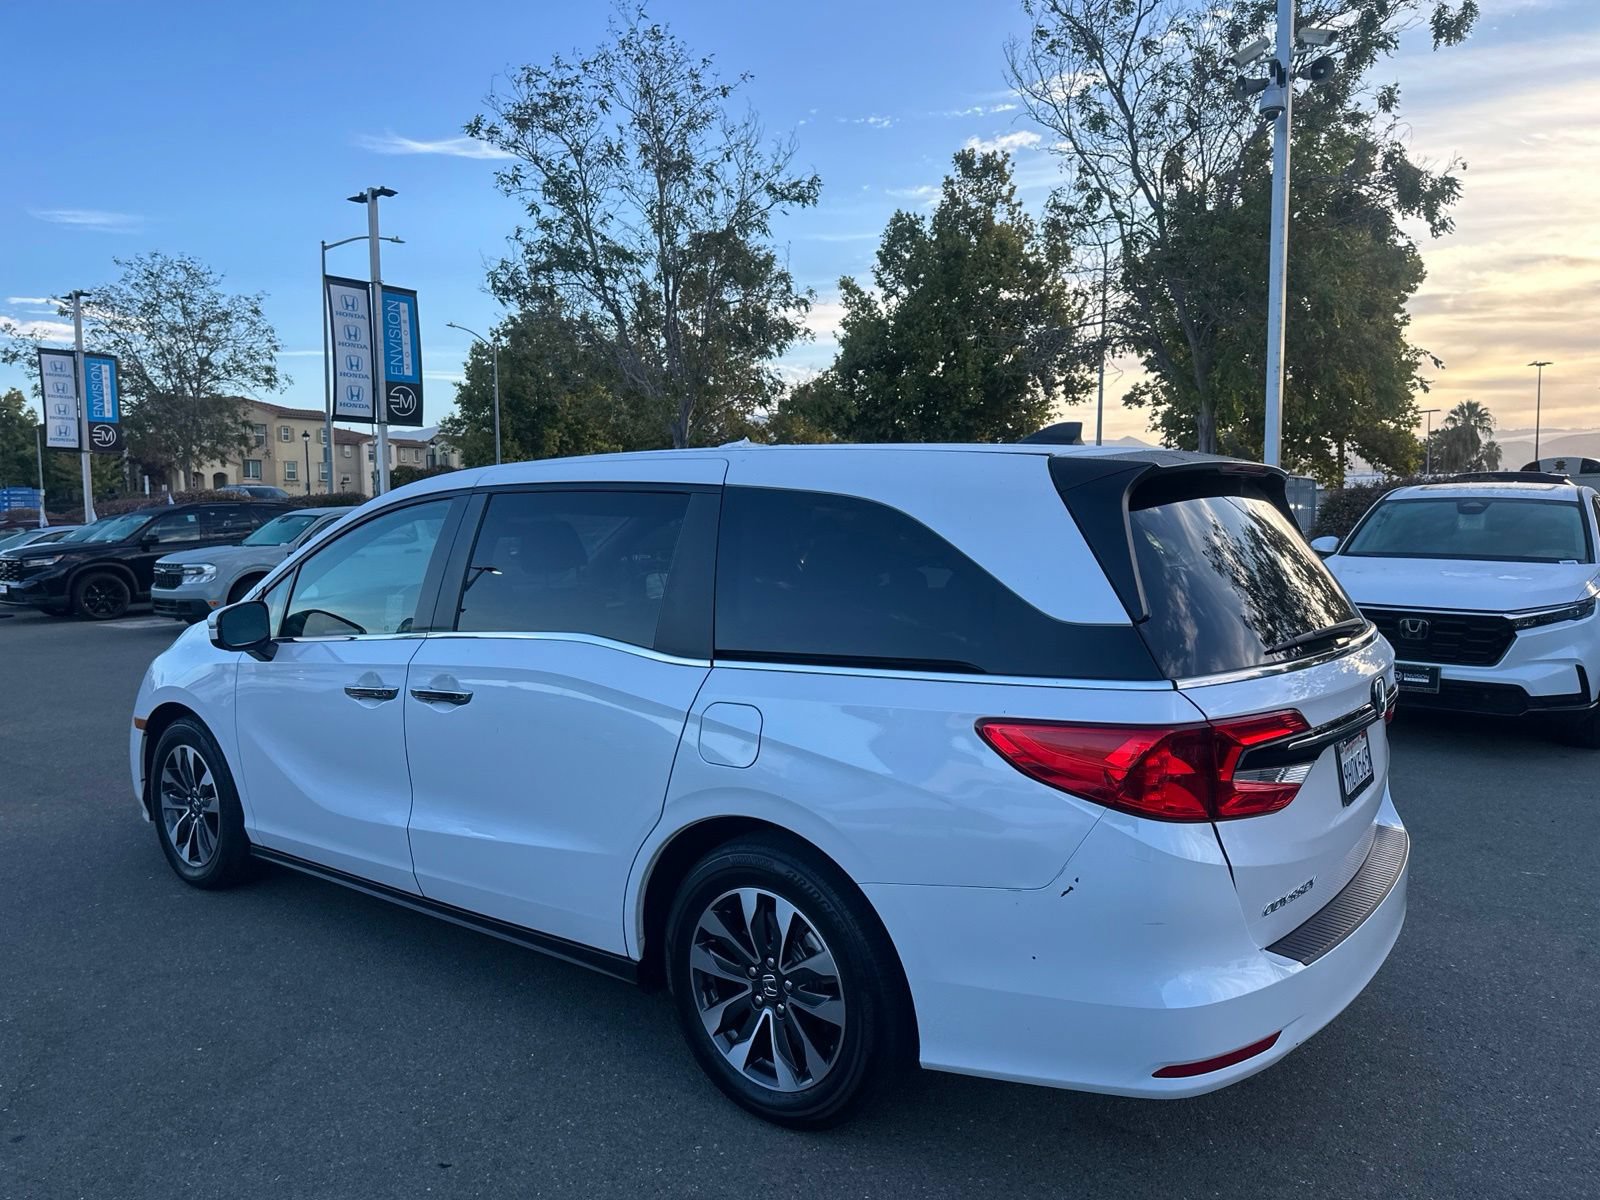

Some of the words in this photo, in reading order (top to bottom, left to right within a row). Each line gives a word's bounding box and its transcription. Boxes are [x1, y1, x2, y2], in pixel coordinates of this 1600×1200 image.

[335, 311, 367, 320] HONDA
[387, 300, 403, 376] ENVISION
[338, 341, 368, 350] HONDA
[339, 371, 370, 380] HONDA
[90, 363, 105, 417] ENVISION
[339, 402, 370, 410] HONDA
